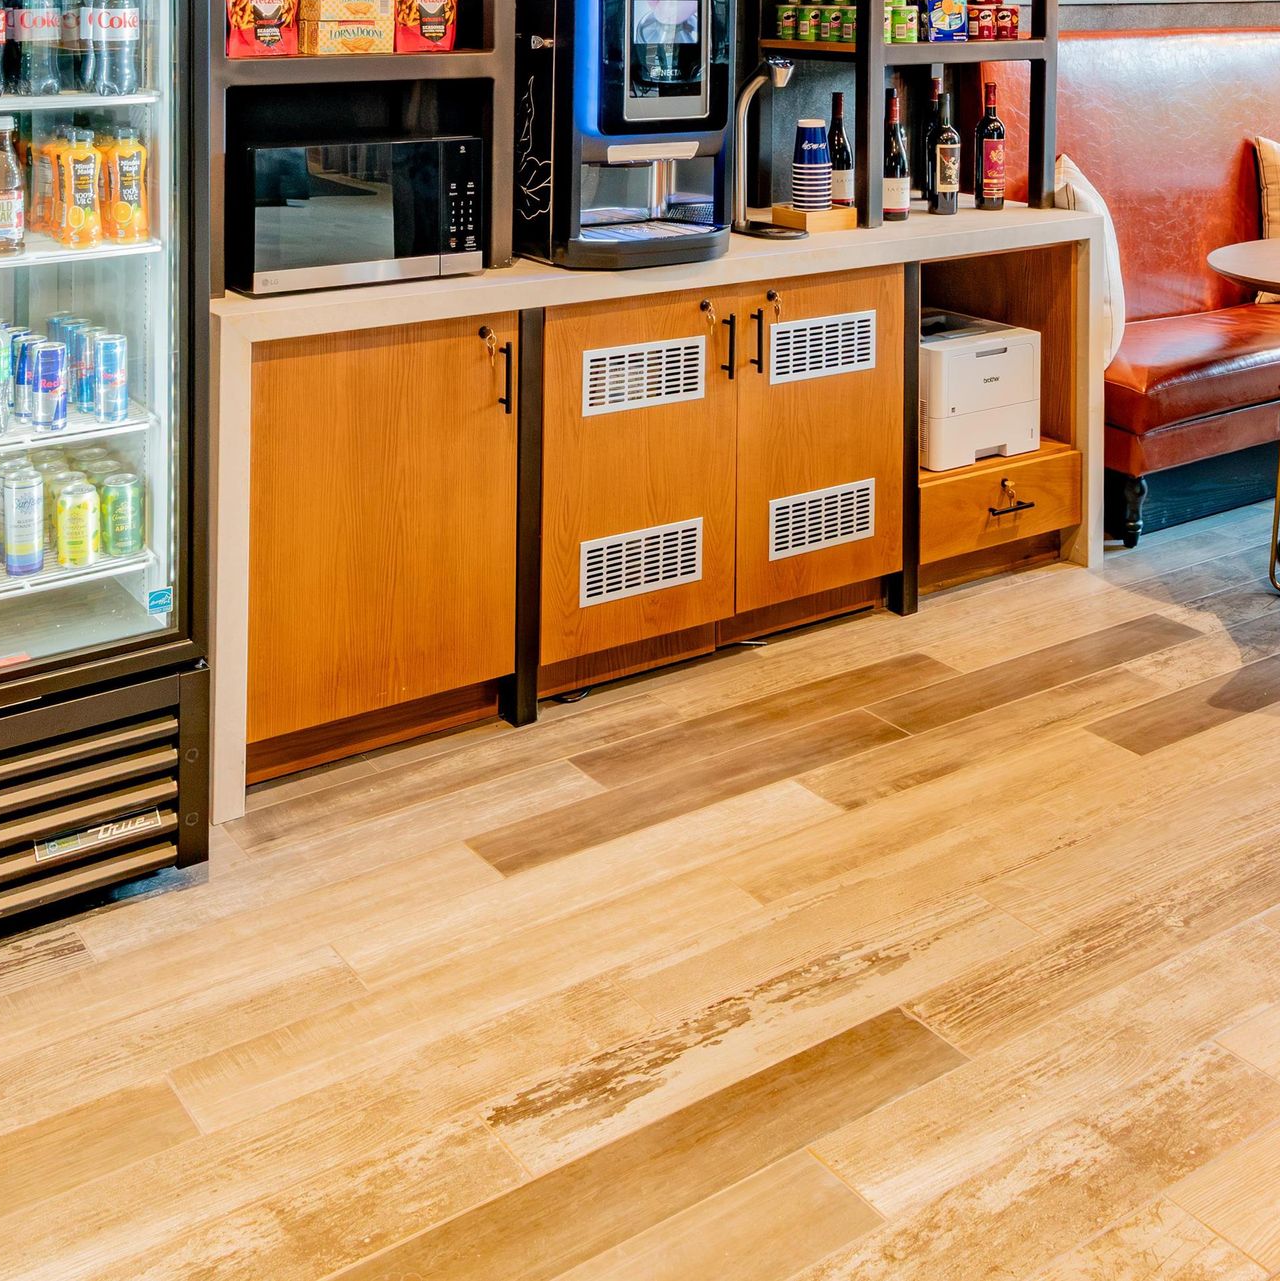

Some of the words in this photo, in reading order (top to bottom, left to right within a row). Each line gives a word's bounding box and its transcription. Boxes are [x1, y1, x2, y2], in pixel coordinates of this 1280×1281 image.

[21, 11, 61, 29] Coke
[98, 11, 138, 29] Coke
[330, 28, 356, 40] LORNA
[356, 27, 384, 39] DOONE
